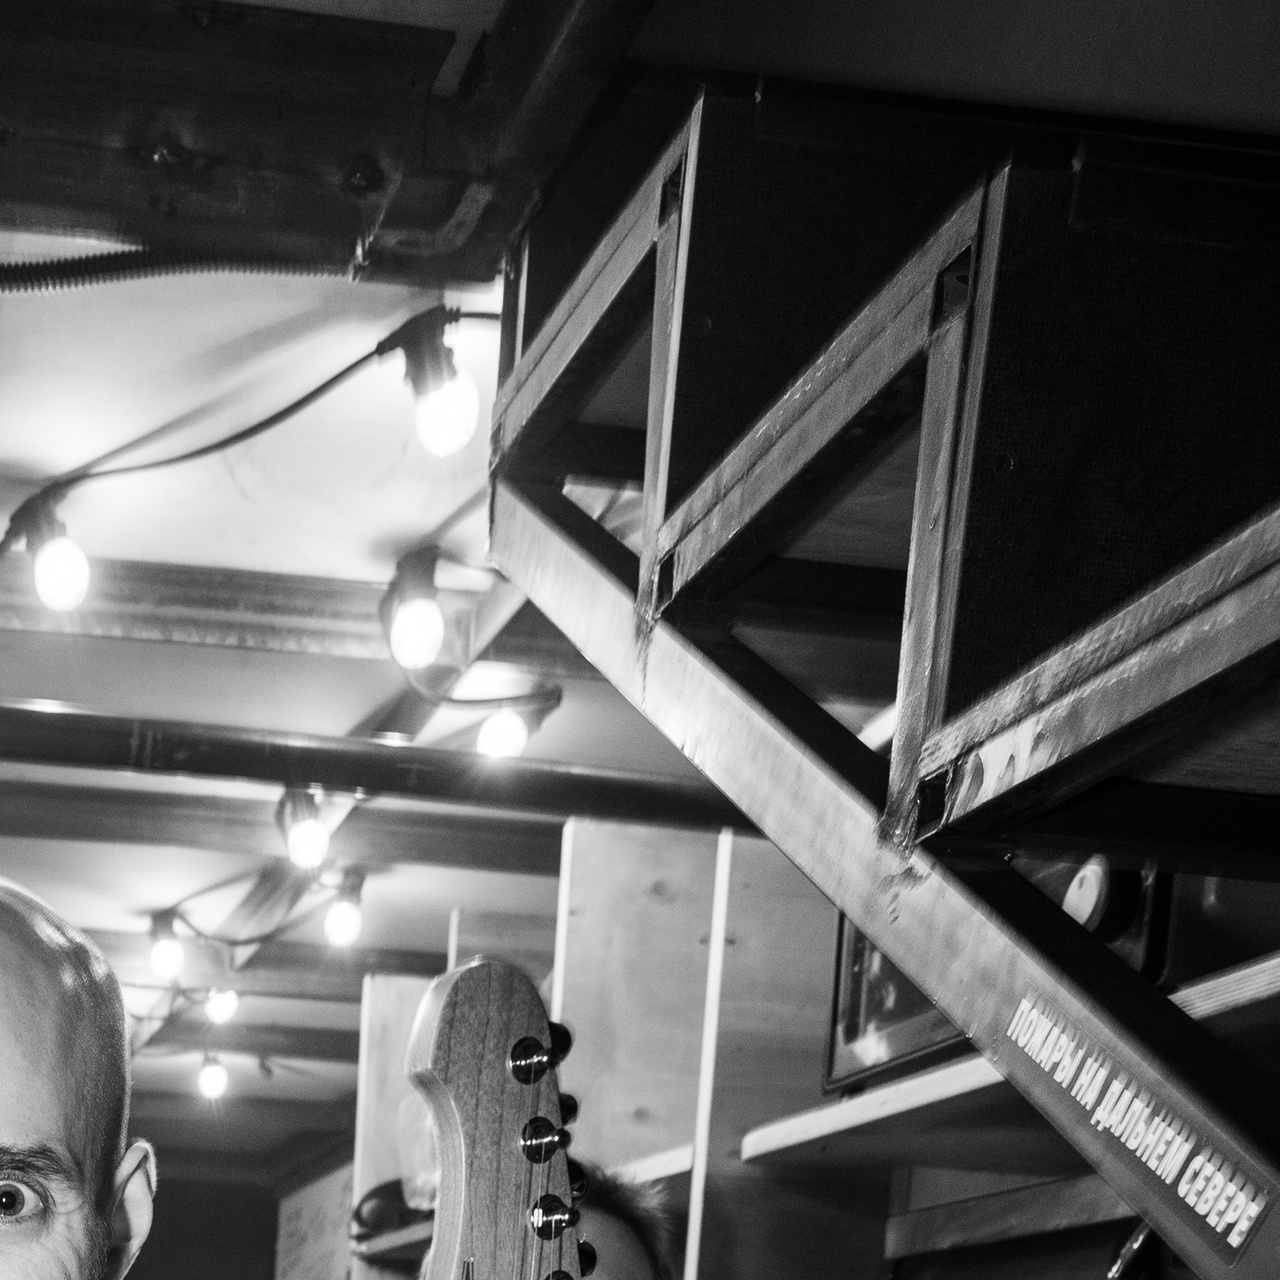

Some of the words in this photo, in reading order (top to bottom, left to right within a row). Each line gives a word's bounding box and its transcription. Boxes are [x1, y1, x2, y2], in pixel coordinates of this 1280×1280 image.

[1006, 998, 1085, 1089] ПОЖАРЫ
[1070, 1056, 1109, 1111] НА
[1090, 1078, 1193, 1185] ДАЛЬНЕМ
[1177, 1154, 1261, 1249] СЕВЕРЕ
